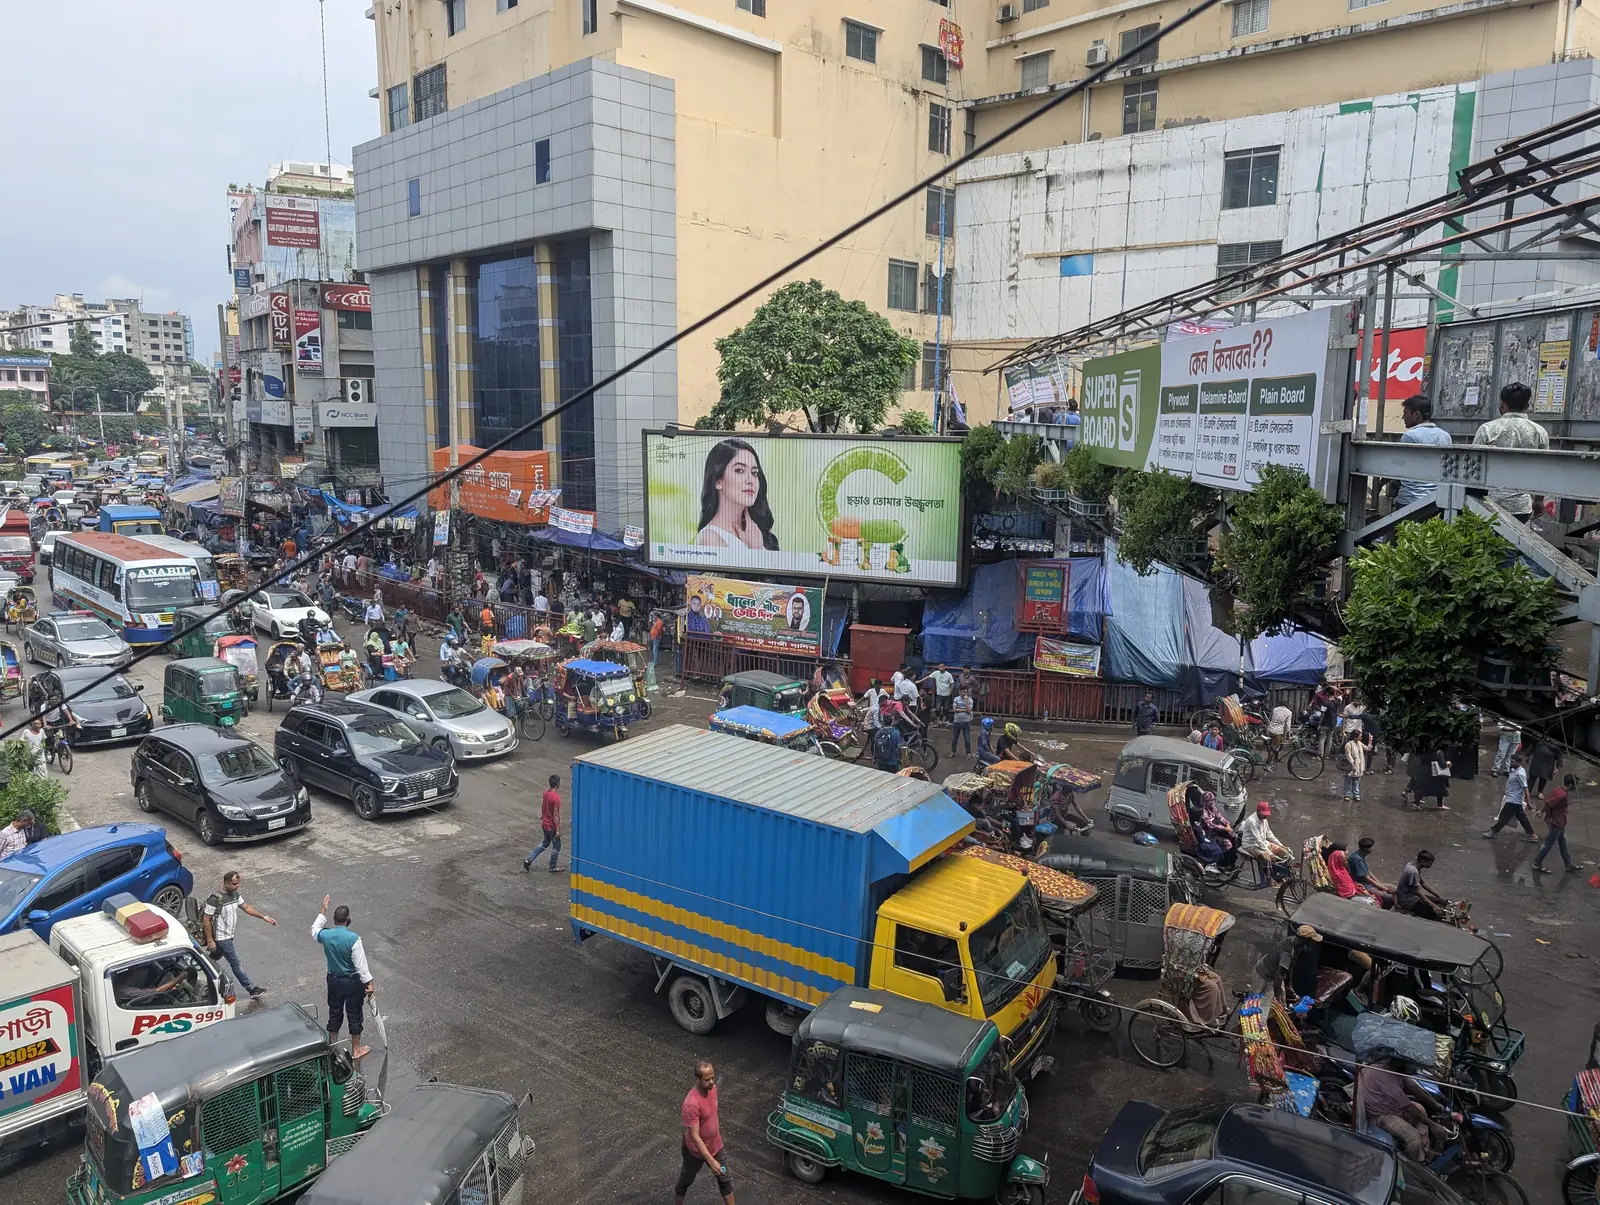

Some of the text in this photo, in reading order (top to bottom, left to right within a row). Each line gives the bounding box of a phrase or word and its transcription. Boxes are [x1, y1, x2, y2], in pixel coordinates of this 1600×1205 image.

[273, 198, 284, 206] CA
[1189, 351, 1208, 376] কেন
[1085, 374, 1117, 410] SUPER
[1201, 388, 1248, 405] Melamine Board
[1260, 386, 1306, 404] Plain Board
[1168, 392, 1190, 410] Plywood
[1084, 416, 1116, 448] BOARD
[873, 498, 902, 507] তোমার
[138, 567, 190, 578] ANABIL
[728, 593, 756, 608] ধানের
[734, 607, 773, 620] ভোট দিন
[195, 1010, 224, 1024] 999
[9, 1062, 57, 1096] VAN
